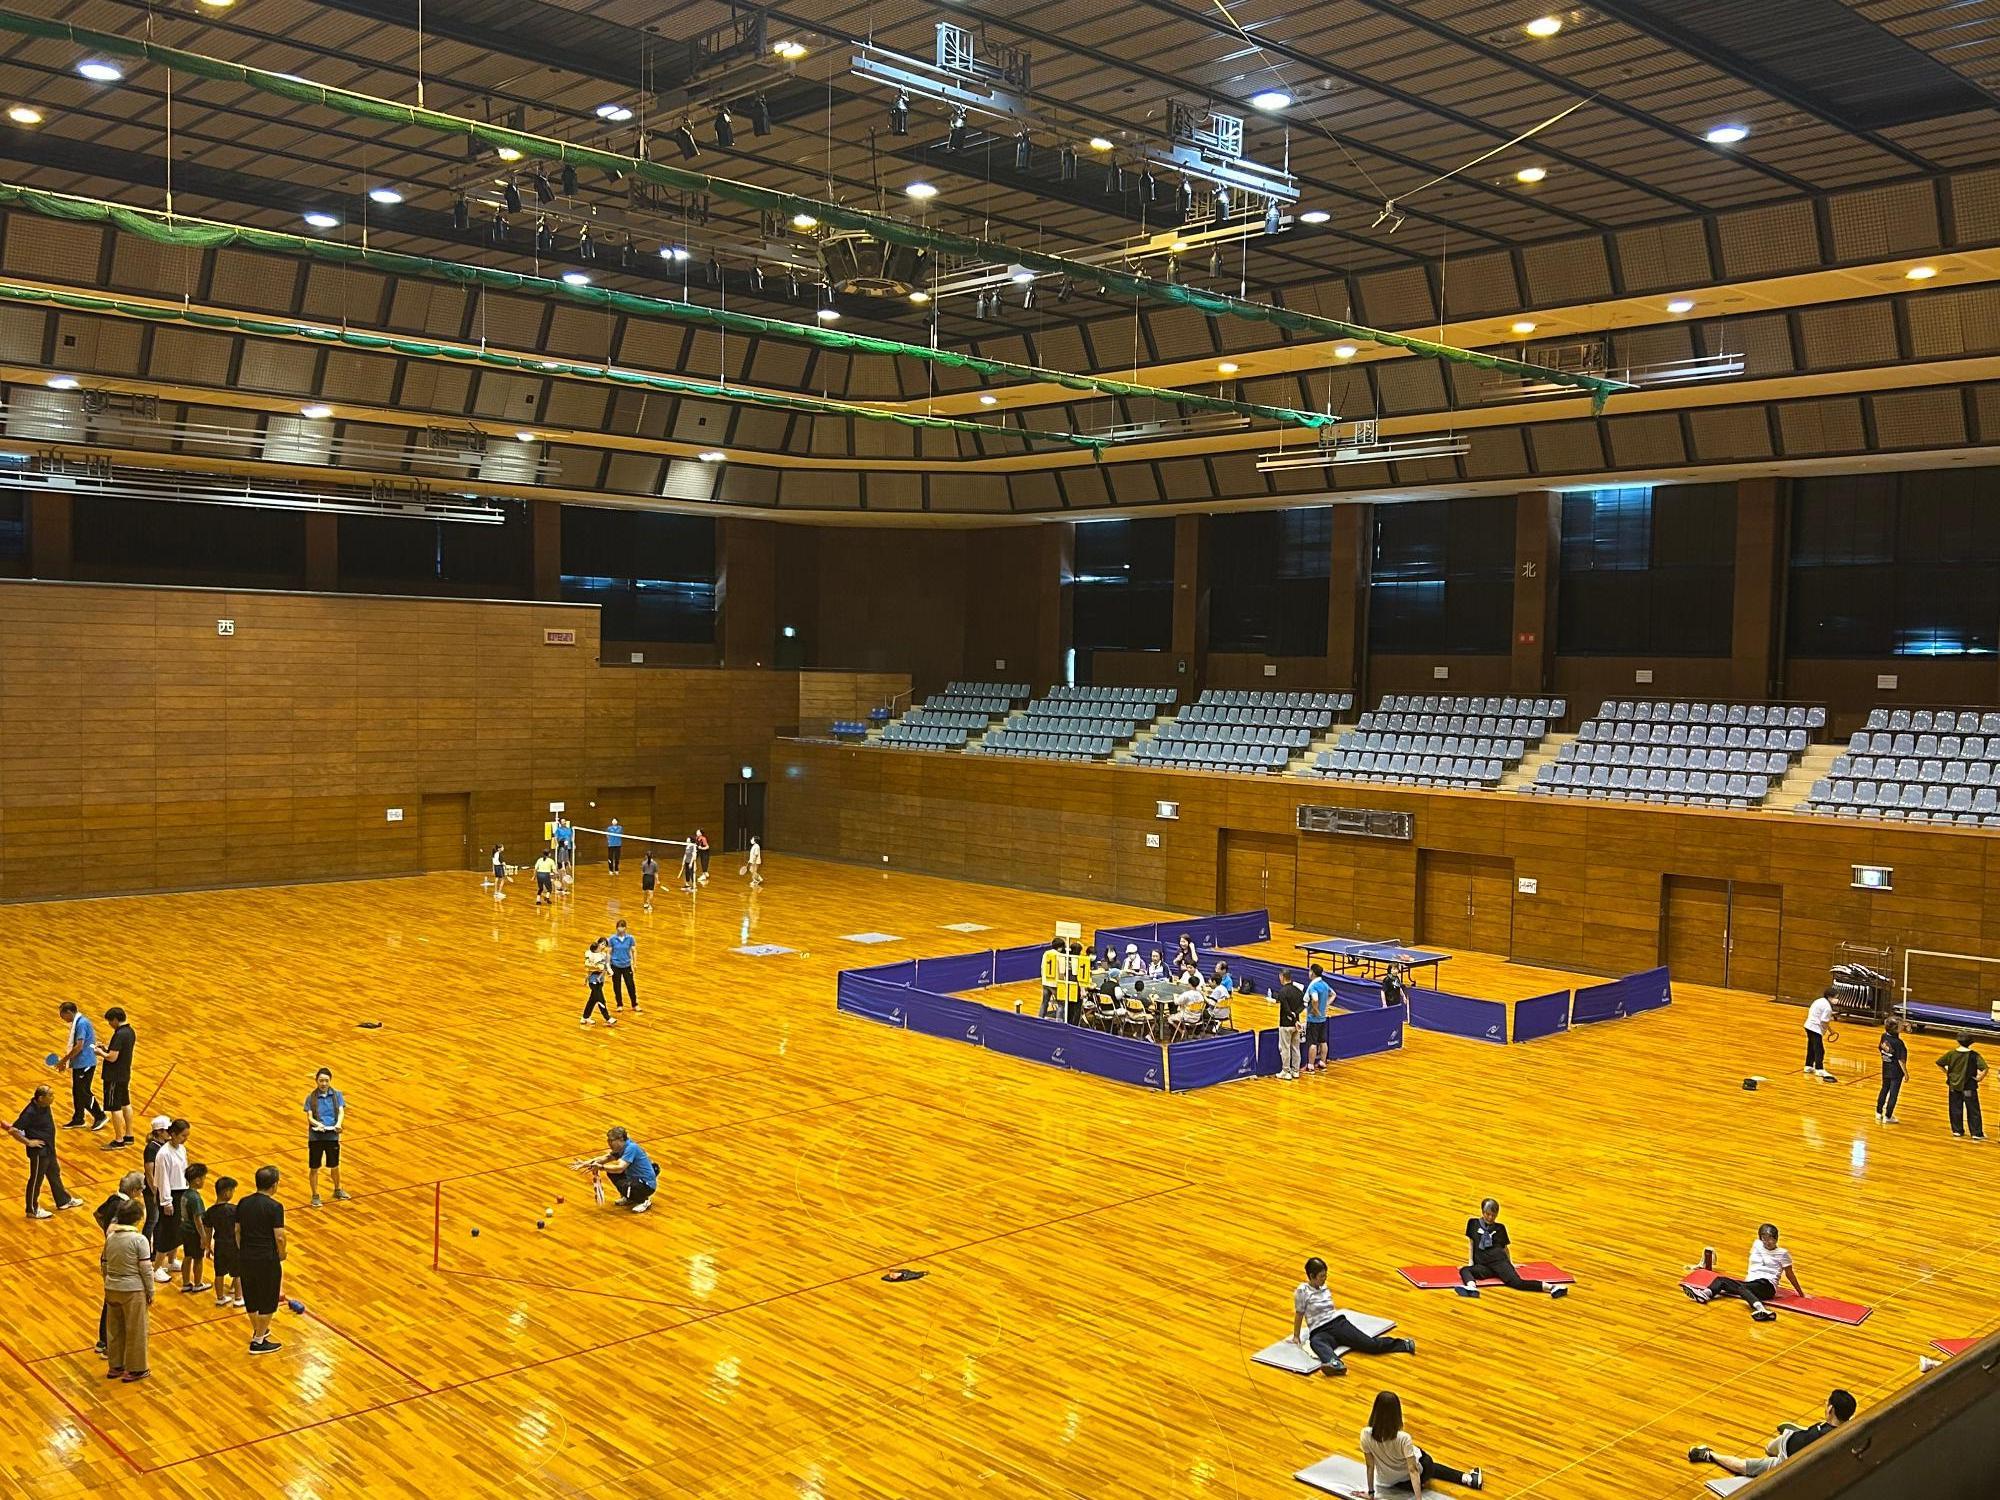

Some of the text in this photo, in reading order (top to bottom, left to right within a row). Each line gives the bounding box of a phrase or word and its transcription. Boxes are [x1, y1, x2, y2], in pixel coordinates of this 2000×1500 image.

[1521, 561, 1537, 578] 北
[217, 619, 235, 636] 西
[1046, 959, 1052, 976] 1
[1080, 963, 1086, 980] 1
